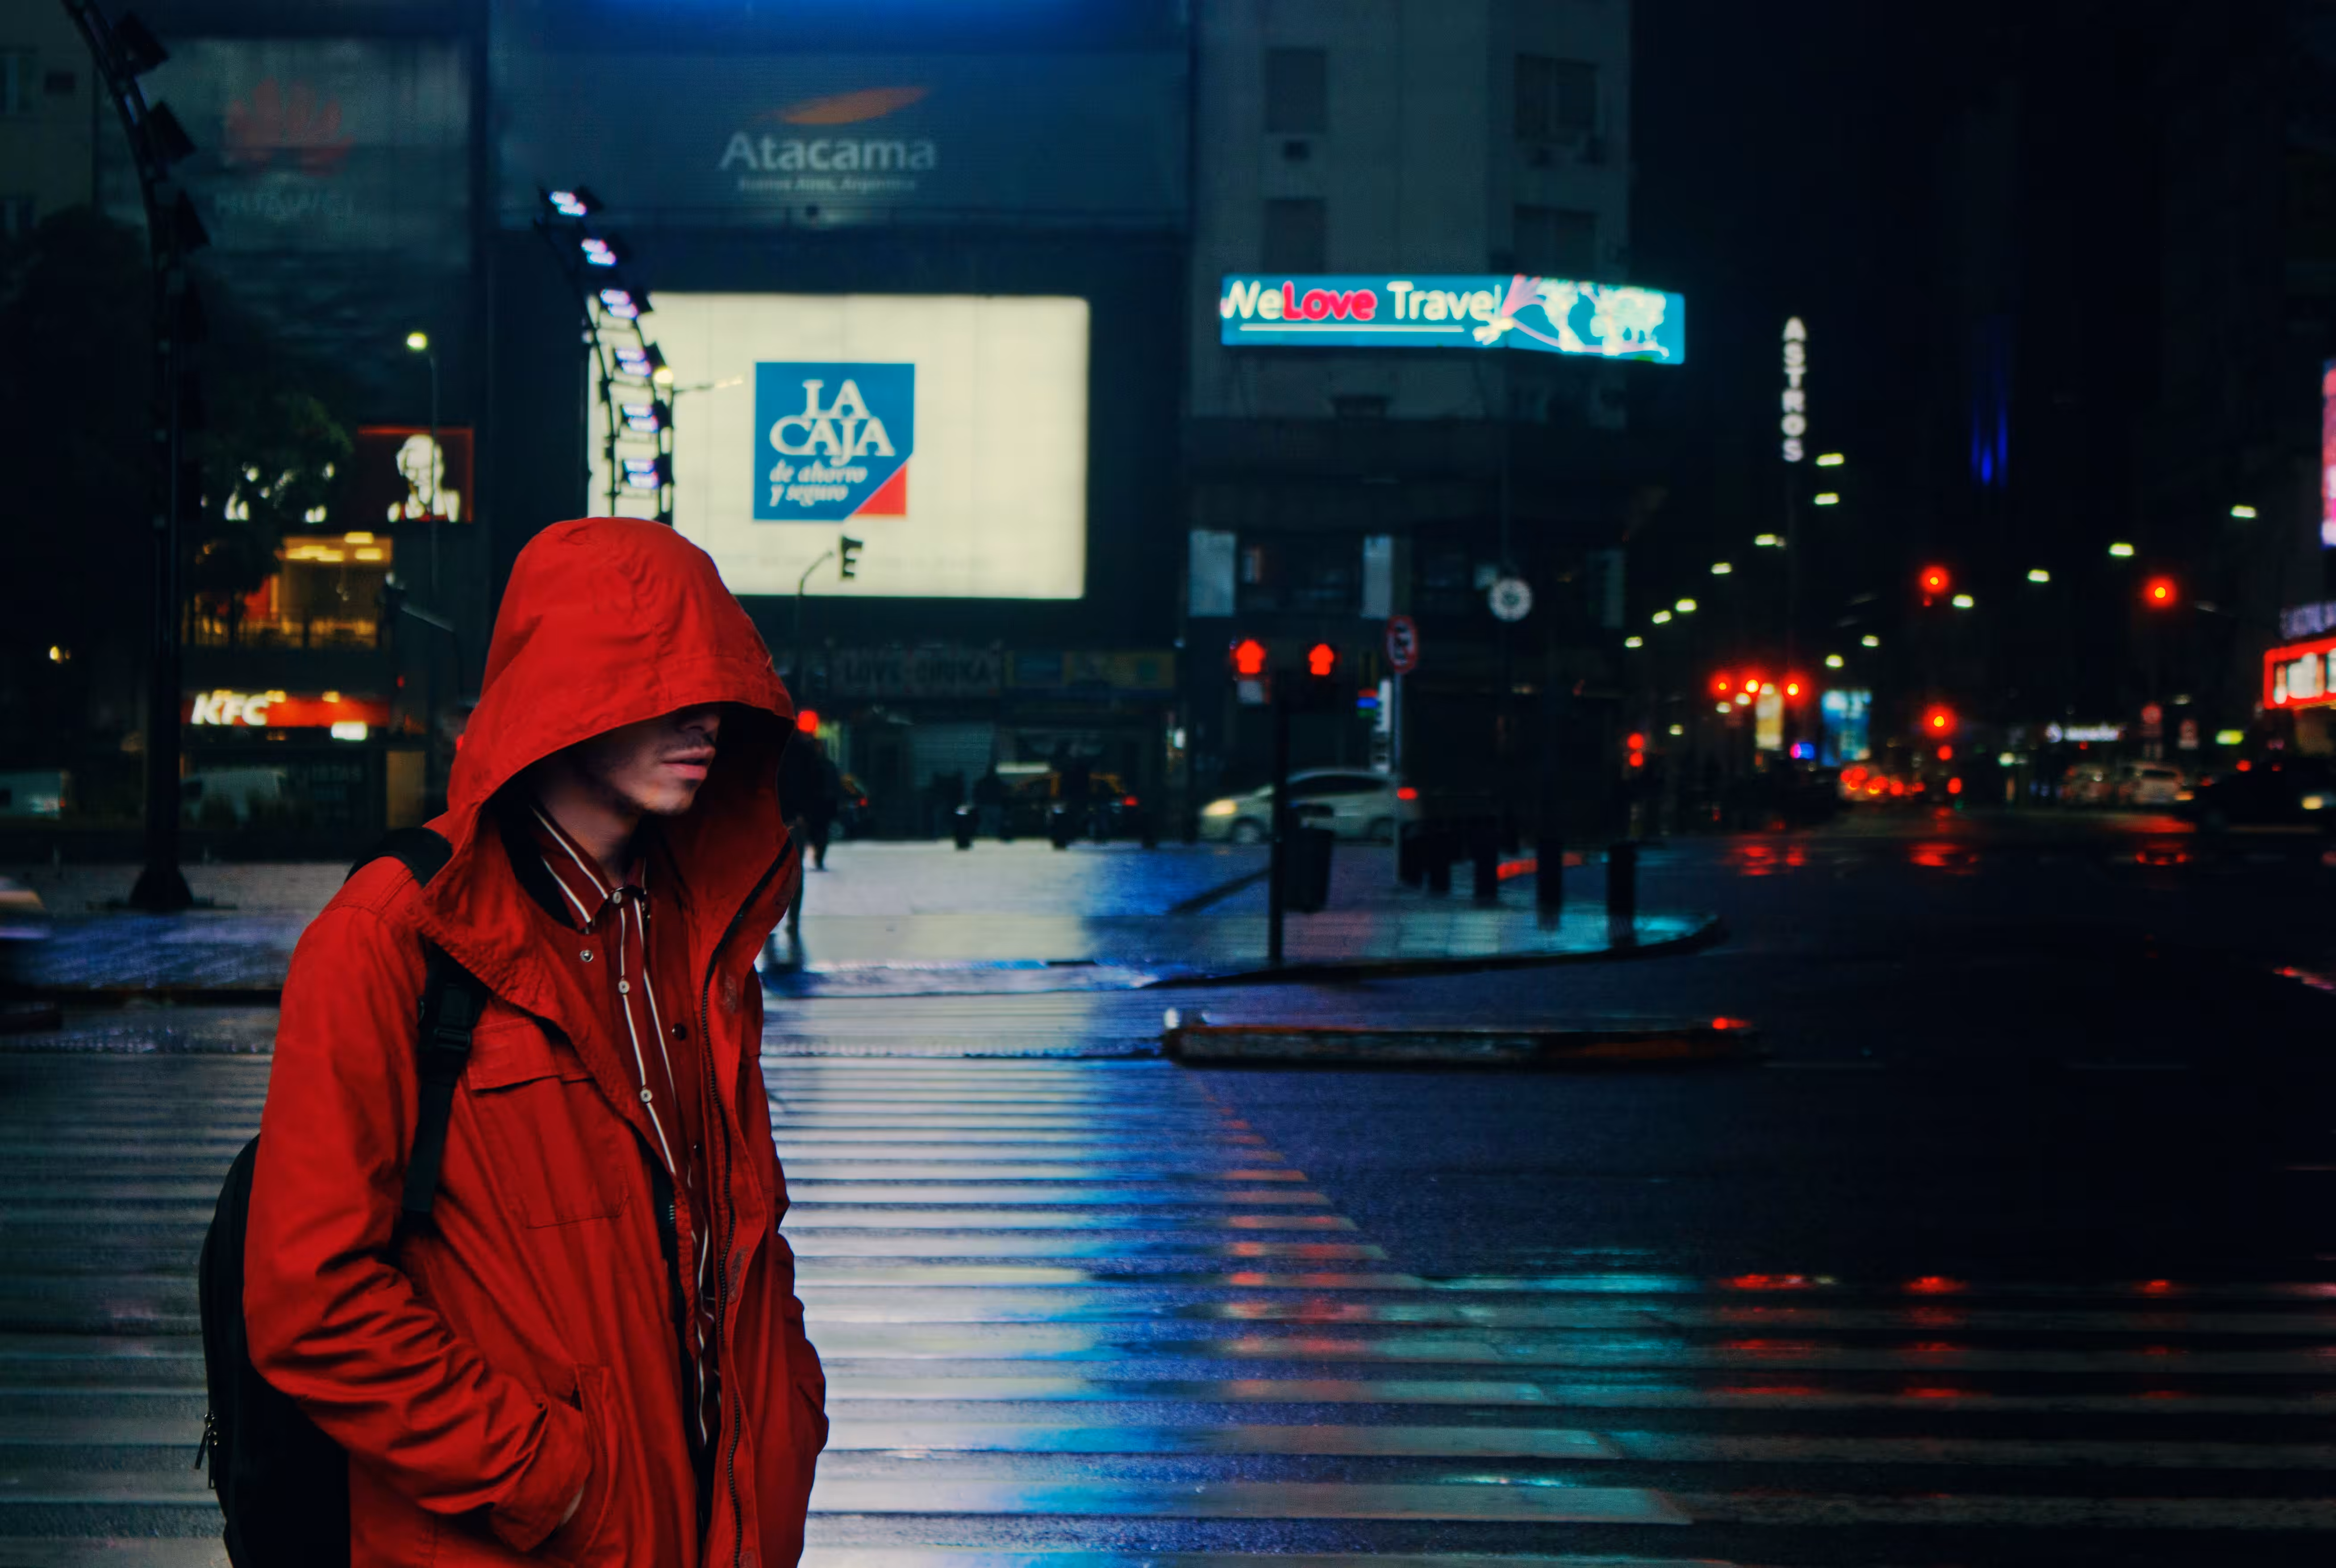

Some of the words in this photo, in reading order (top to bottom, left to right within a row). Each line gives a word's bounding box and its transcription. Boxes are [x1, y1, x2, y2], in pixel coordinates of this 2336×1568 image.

[718, 133, 936, 171] Atacama
[1386, 280, 1502, 321] Travel
[803, 379, 871, 419] LA
[1781, 315, 1807, 463] ASTROS
[769, 415, 896, 466] CAJA
[769, 459, 794, 482] de
[798, 459, 868, 483] ahorro
[192, 693, 271, 726] KFC
